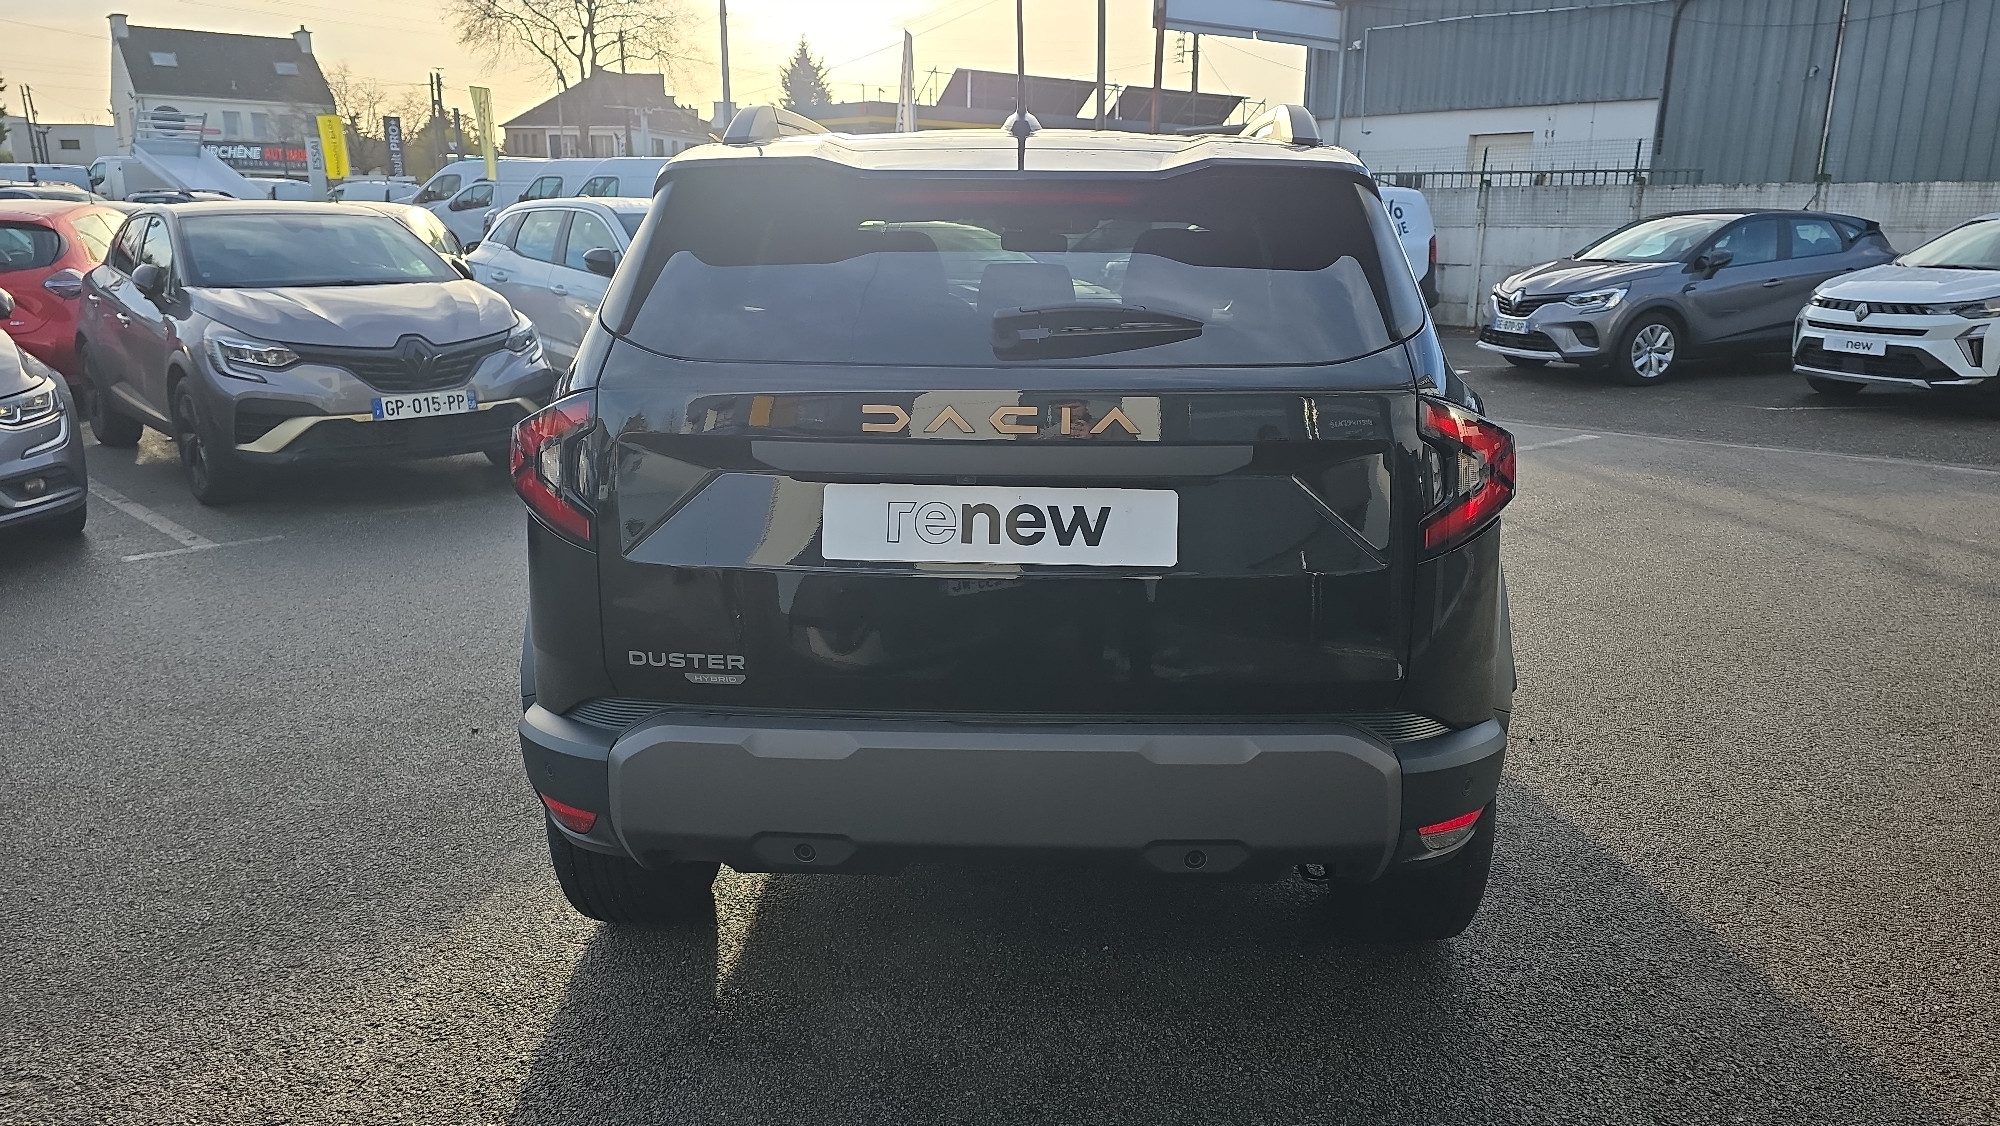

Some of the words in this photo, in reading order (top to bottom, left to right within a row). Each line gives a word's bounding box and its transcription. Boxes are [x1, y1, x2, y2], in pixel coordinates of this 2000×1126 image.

[310, 140, 323, 170] ESSAI
[385, 394, 465, 416] GP-015-PP
[862, 405, 1141, 435] DACIA
[887, 501, 1112, 547] renew
[628, 650, 745, 670] DUSTER
[694, 675, 737, 683] HYBRID
